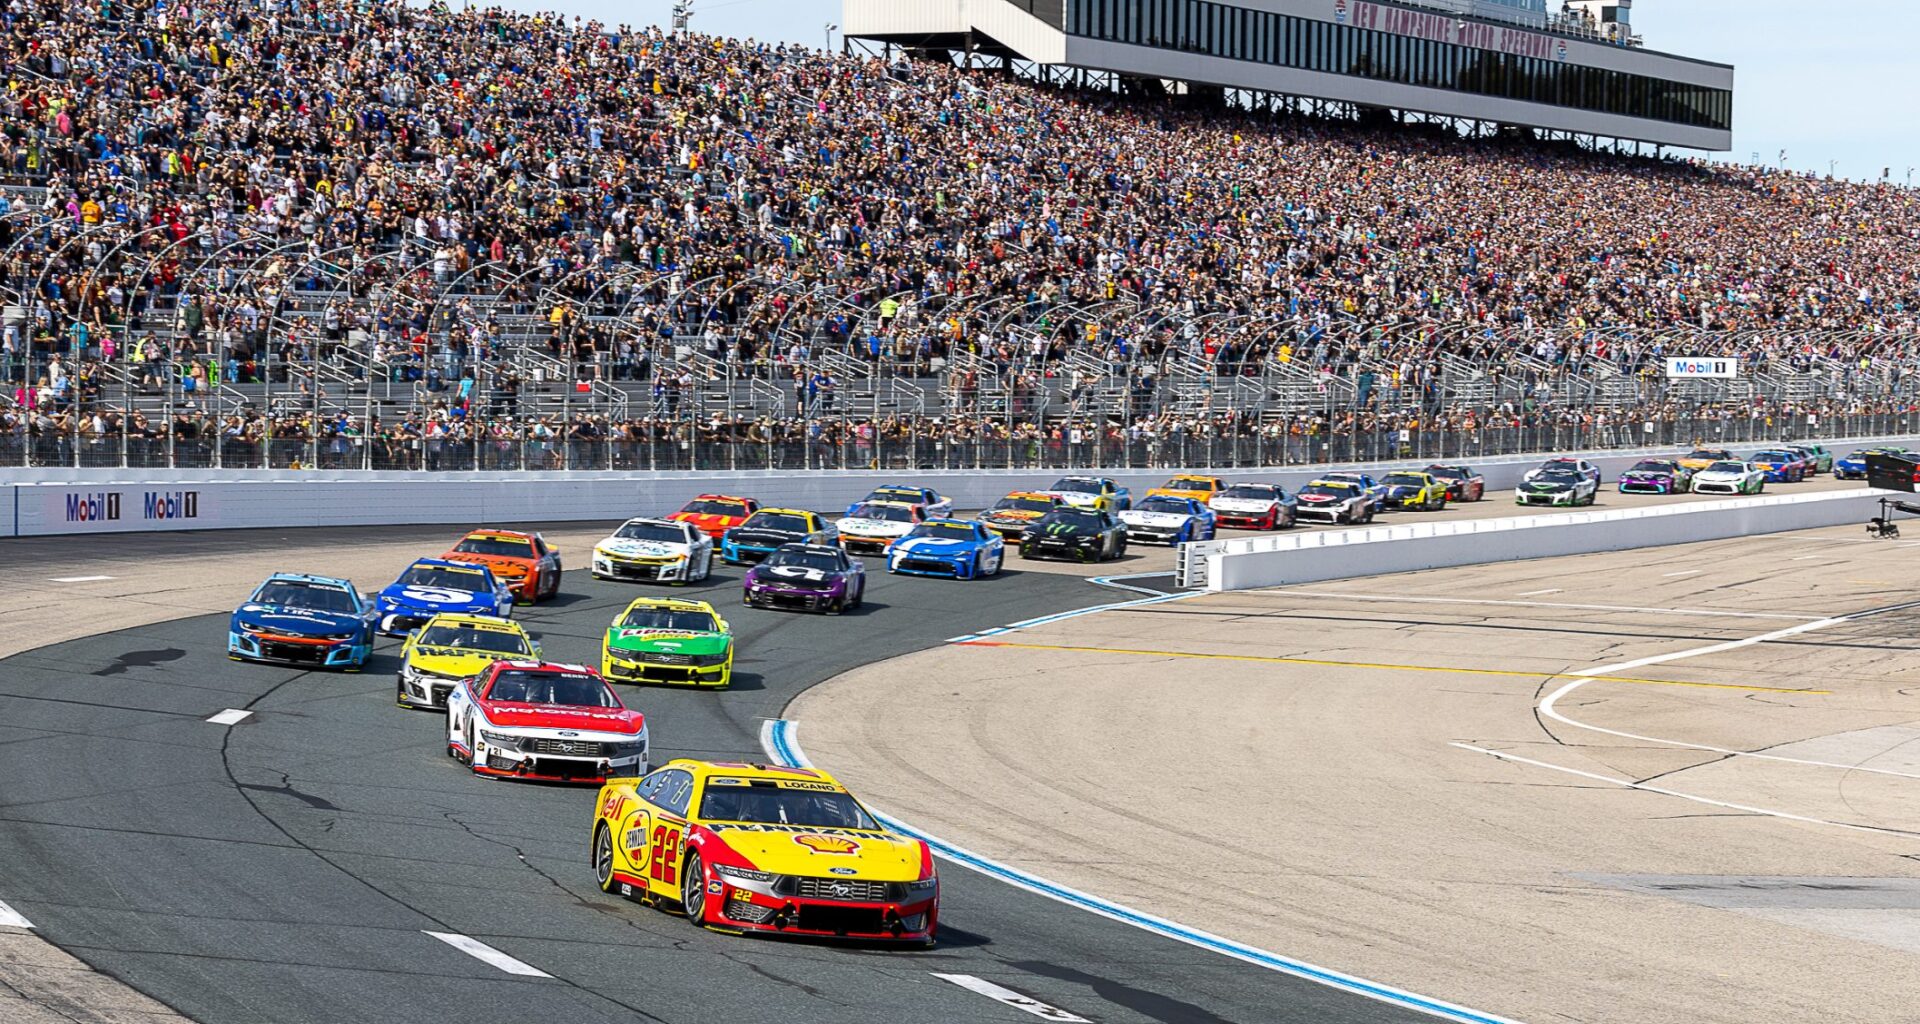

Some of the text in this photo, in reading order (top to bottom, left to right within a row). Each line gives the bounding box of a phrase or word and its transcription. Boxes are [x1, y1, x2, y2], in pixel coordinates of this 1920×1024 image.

[1353, 1, 1553, 59] NEW HAMPSHIRE MOTOR SPEEDWAY
[1676, 362, 1726, 373] Mobil 1
[66, 493, 105, 521] Mobil
[144, 492, 182, 519] Mobil
[493, 707, 629, 720] Motorcraft
[494, 748, 502, 756] 21
[784, 781, 835, 792] LOGANO
[650, 825, 680, 885] 22
[734, 889, 753, 902] 22
